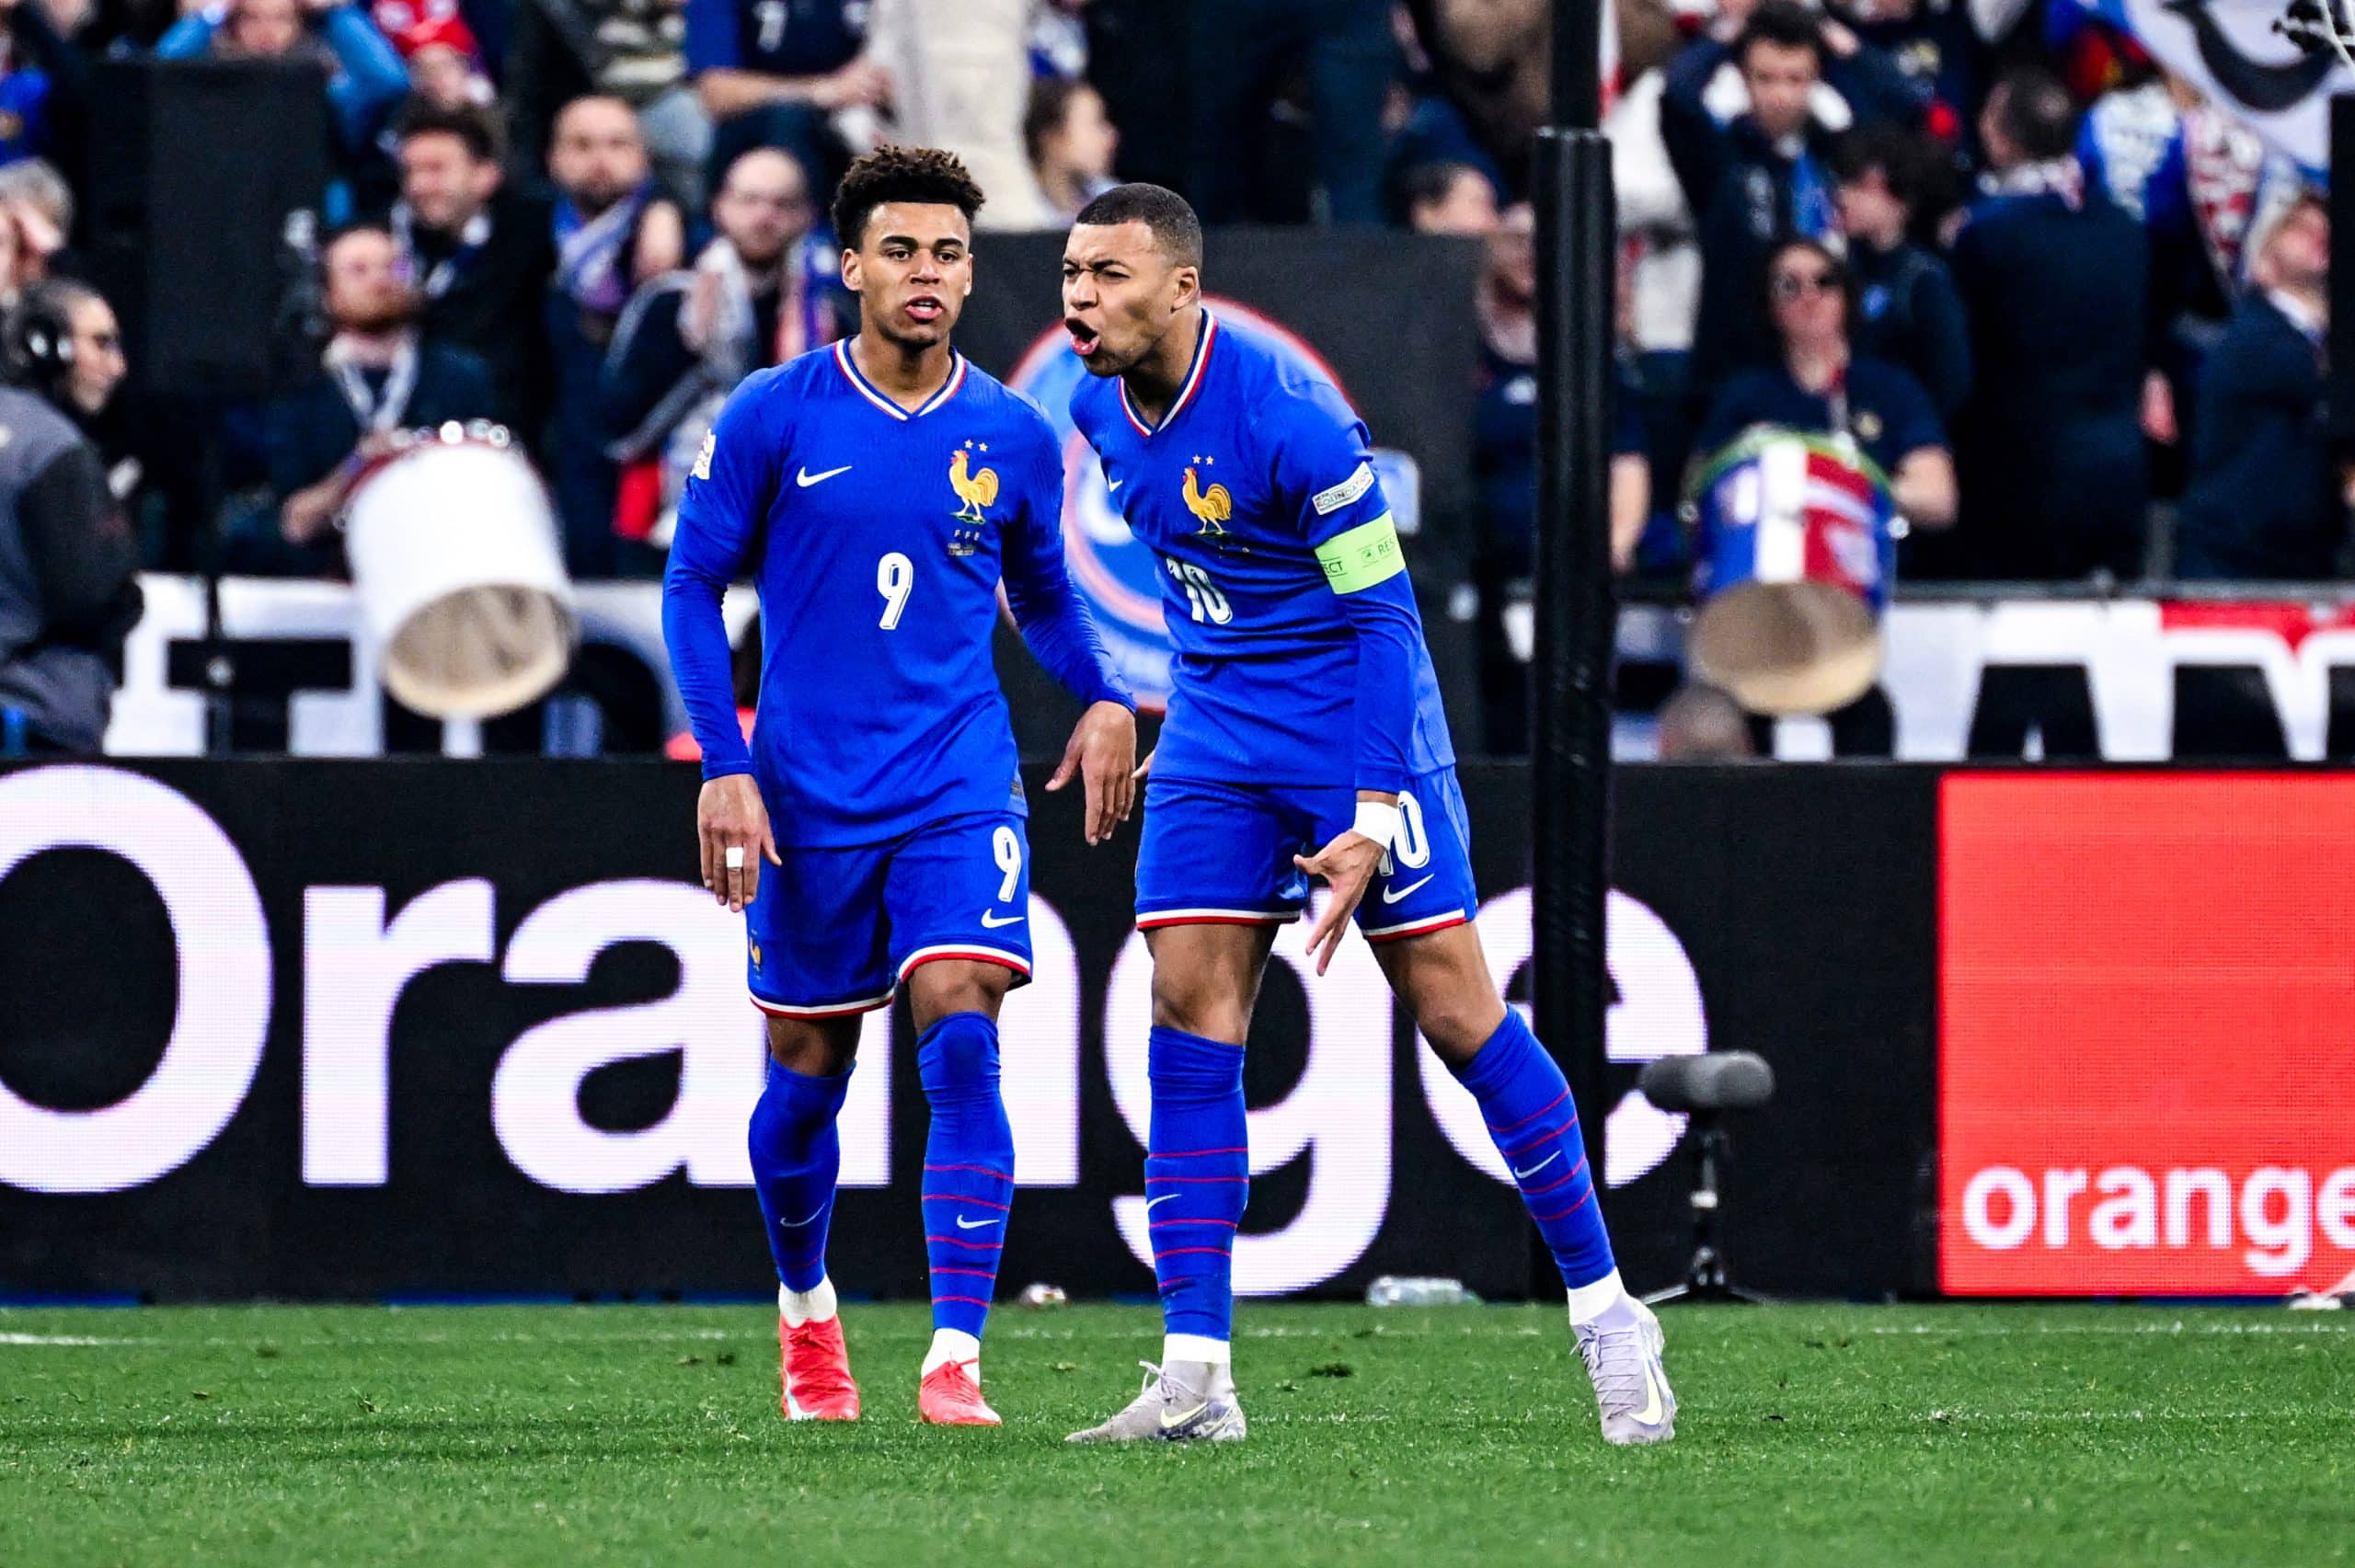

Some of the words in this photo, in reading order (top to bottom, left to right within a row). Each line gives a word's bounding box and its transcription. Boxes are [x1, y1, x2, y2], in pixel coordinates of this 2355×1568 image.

[877, 552, 913, 630] 9
[1166, 555, 1234, 624] 10
[993, 826, 1022, 903] 9
